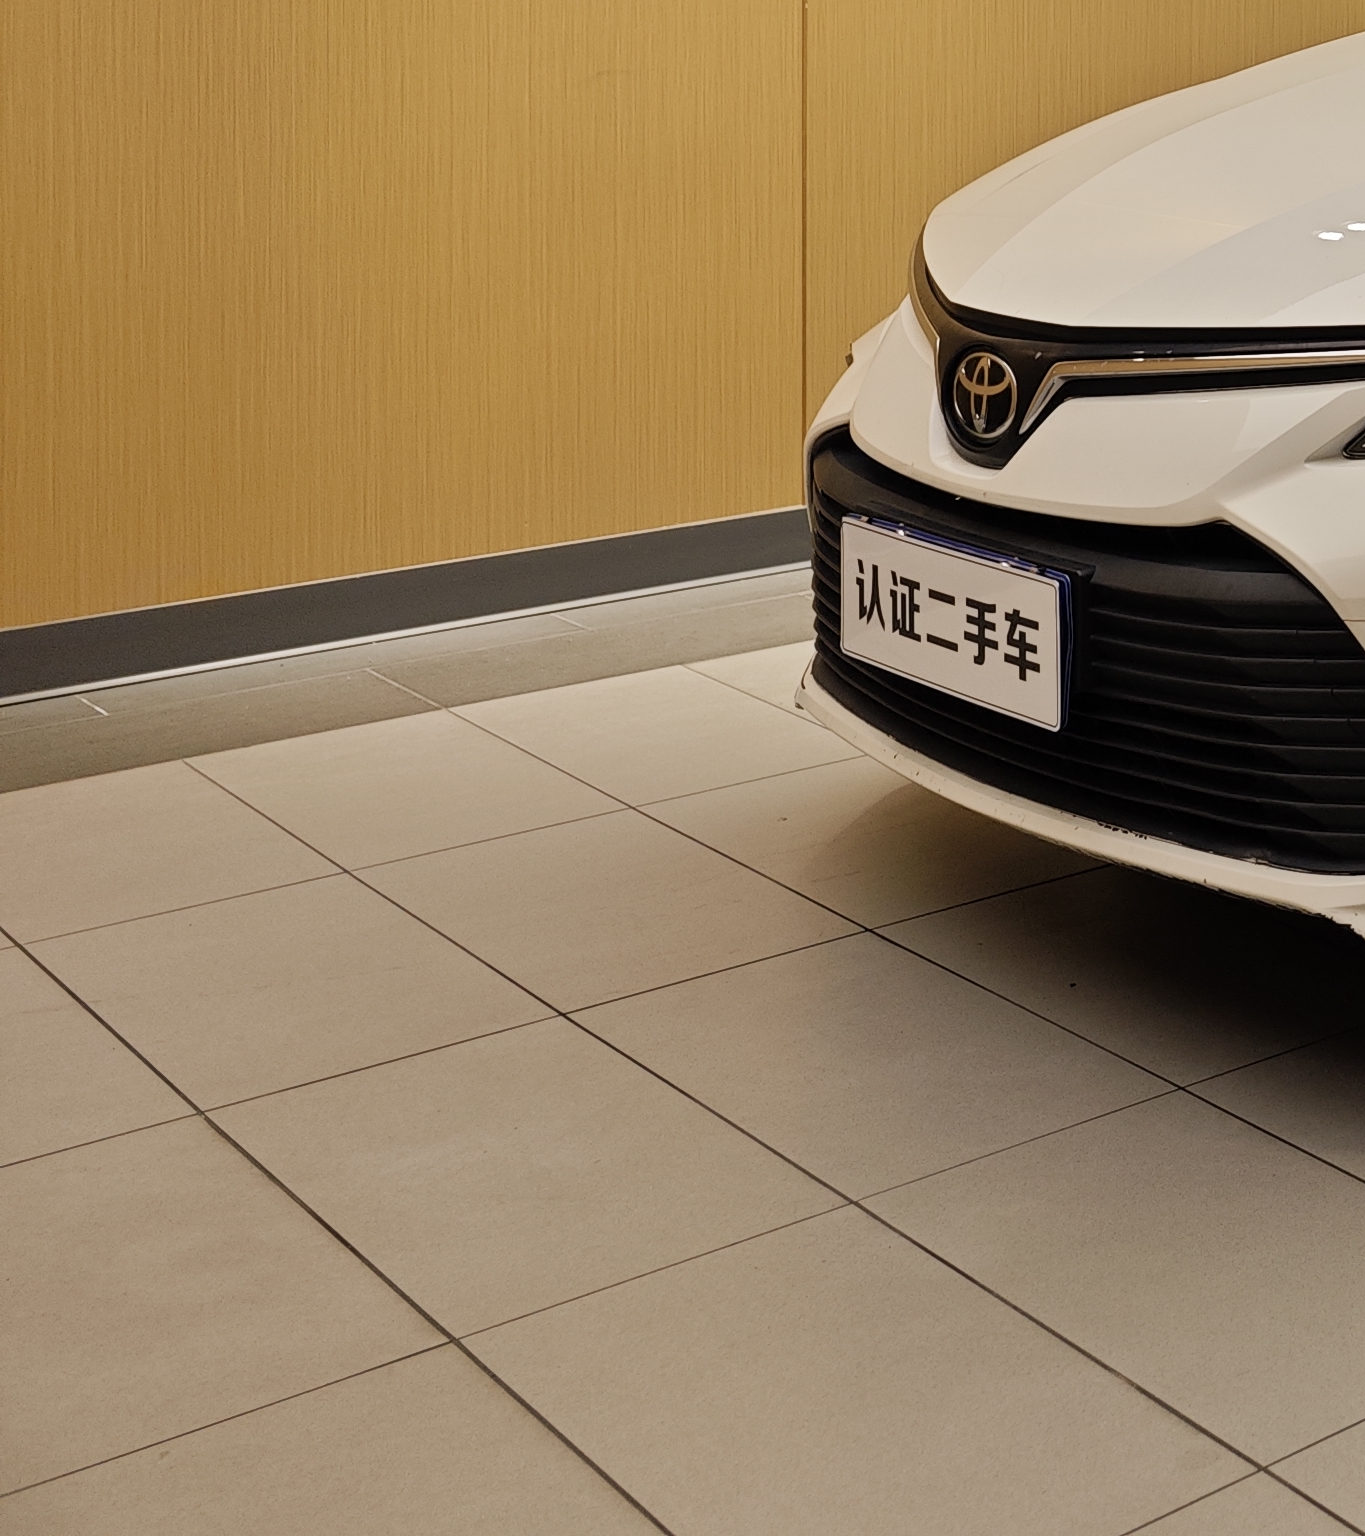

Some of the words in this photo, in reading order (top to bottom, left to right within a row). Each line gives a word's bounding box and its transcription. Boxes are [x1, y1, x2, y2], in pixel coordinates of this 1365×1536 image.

[856, 558, 1040, 682] 认证二手车
